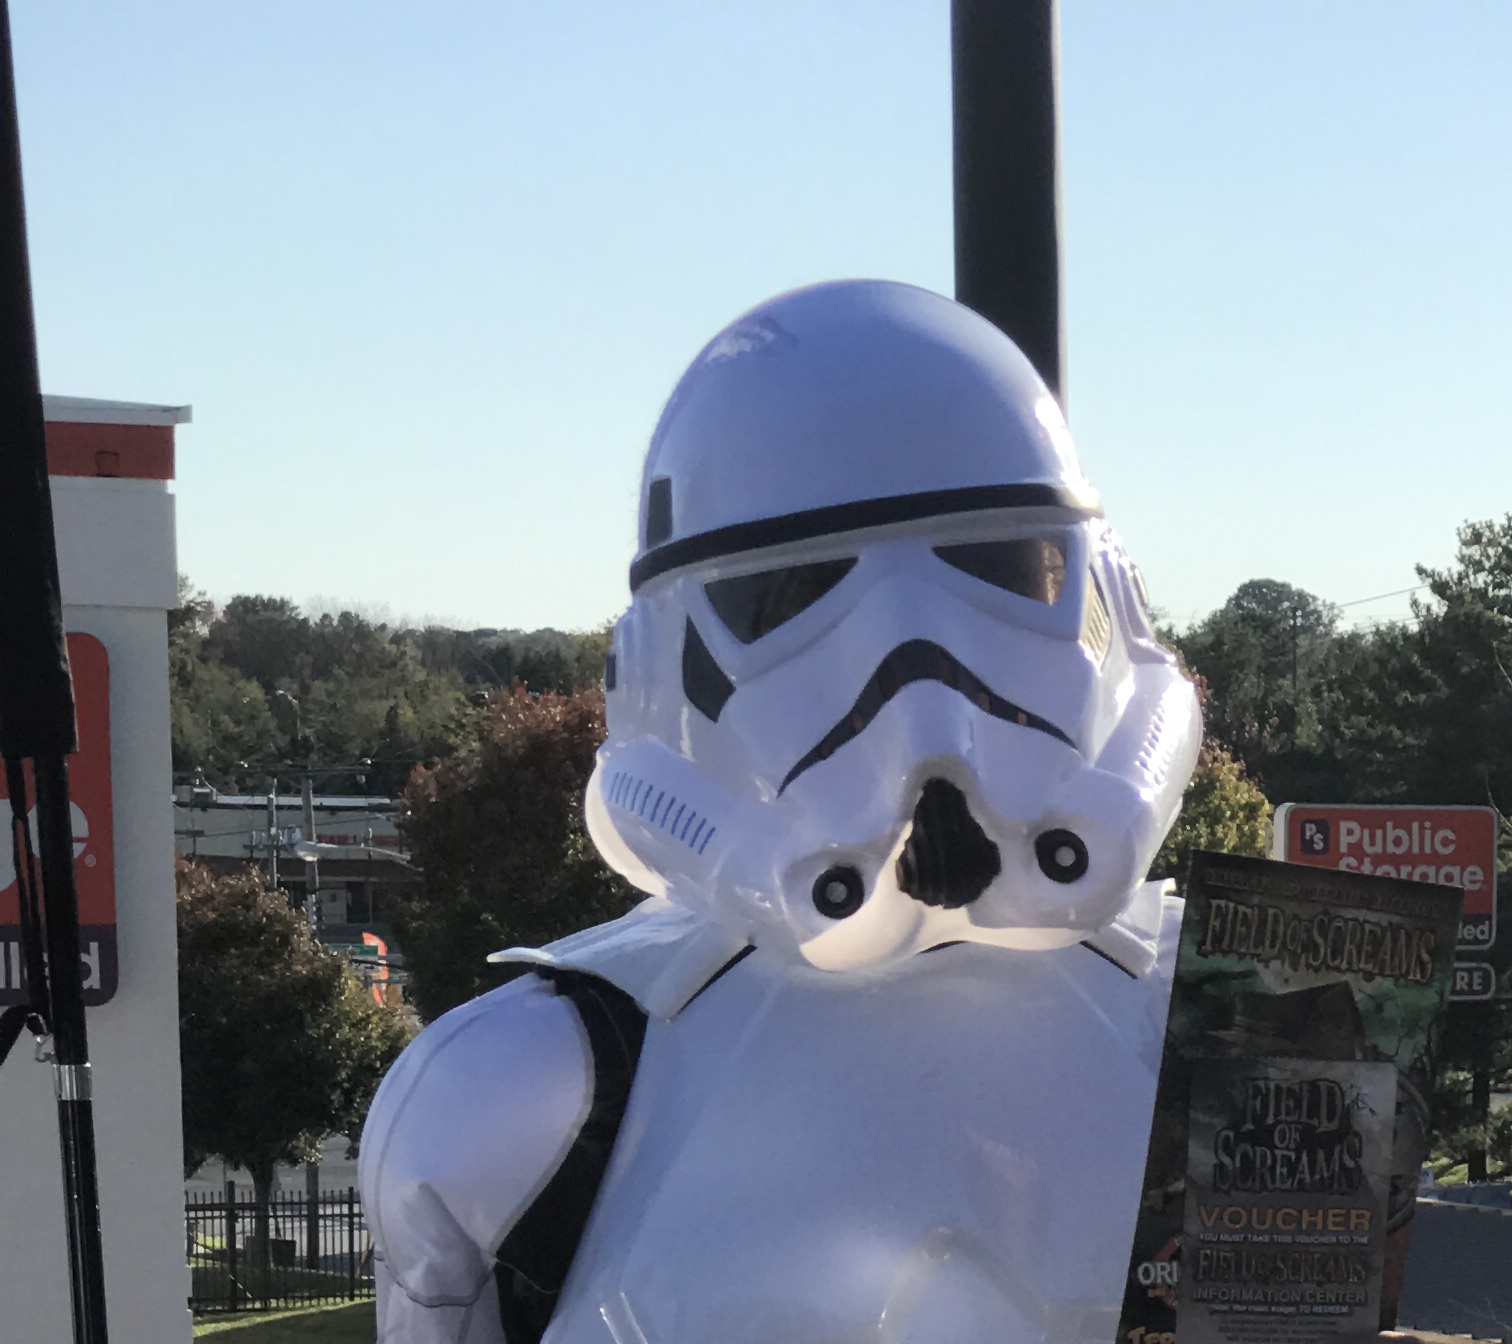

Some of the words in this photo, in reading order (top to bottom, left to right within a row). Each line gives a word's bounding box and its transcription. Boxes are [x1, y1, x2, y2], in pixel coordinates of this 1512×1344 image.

[1338, 820, 1457, 854] Public
[1203, 898, 1284, 954] FIELD
[1287, 918, 1309, 953] OF
[1309, 912, 1436, 983] SCREAMS
[1243, 1078, 1345, 1131] FIELD
[1273, 1123, 1302, 1149] OF
[1215, 1128, 1363, 1192] SCREAMS
[1200, 1206, 1372, 1231] VOUCHER
[1338, 1234, 1350, 1244] TO
[1276, 1250, 1367, 1284] SCREAMS
[1194, 1287, 1300, 1303] INFORMATION
[1305, 1287, 1367, 1303] CENTER
